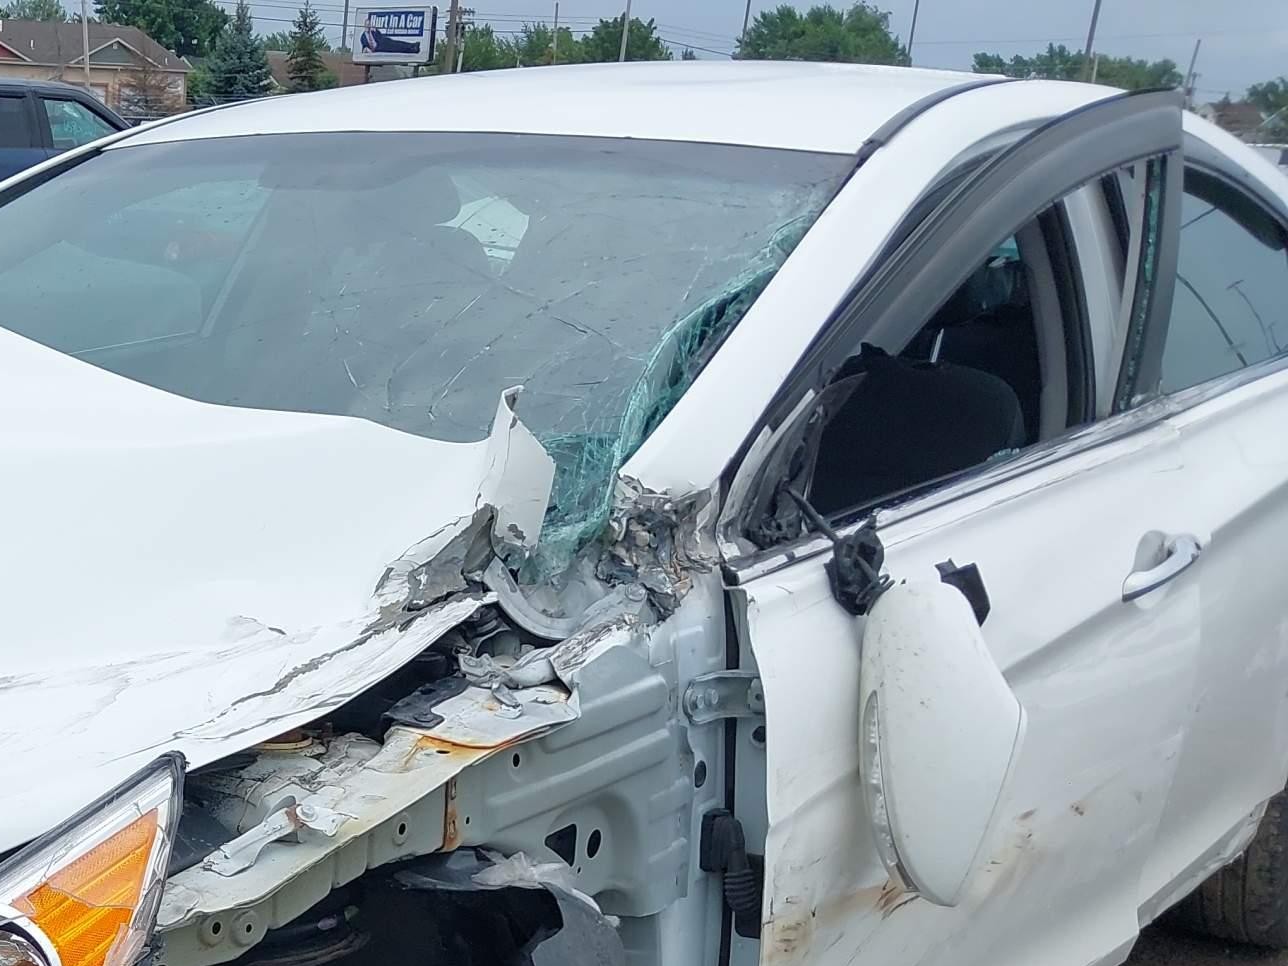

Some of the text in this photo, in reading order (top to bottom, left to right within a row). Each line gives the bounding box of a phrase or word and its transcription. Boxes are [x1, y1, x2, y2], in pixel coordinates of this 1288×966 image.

[370, 13, 423, 28] Hurt In A Car
